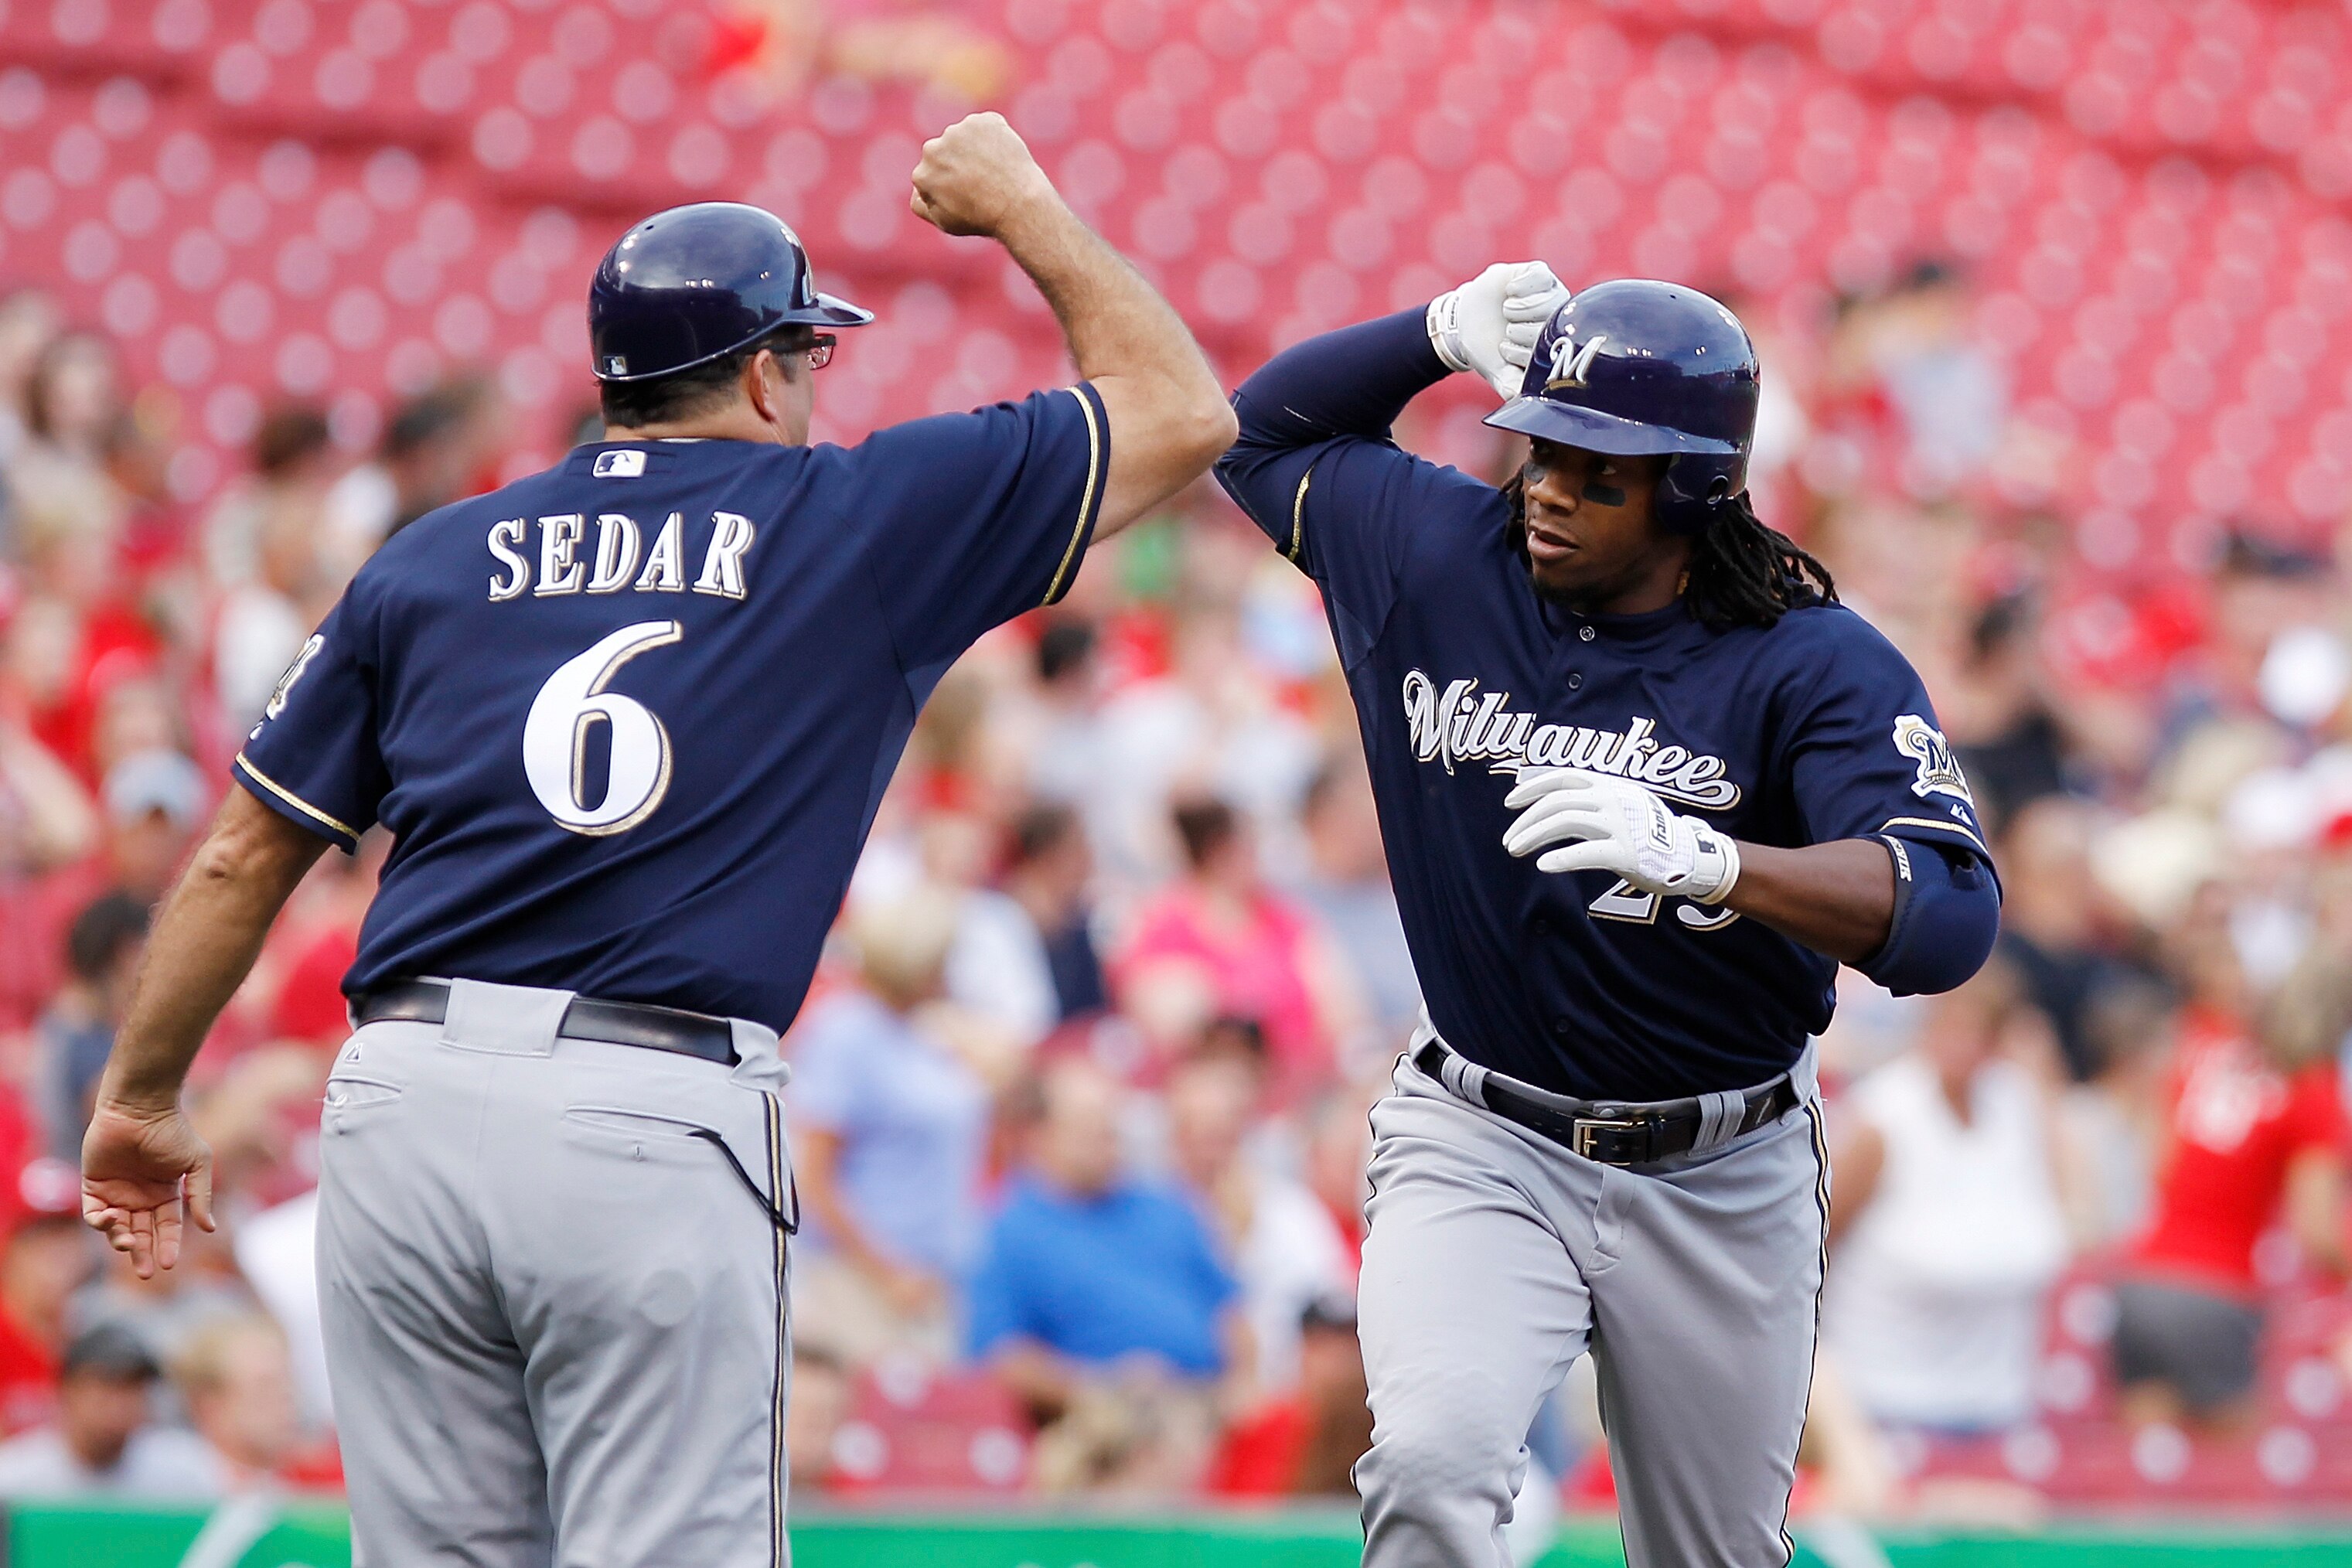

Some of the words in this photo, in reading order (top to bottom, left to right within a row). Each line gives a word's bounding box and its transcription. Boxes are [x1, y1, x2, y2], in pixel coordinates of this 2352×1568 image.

[487, 511, 755, 602] SEDAR
[521, 619, 683, 836] 6
[1403, 667, 1741, 810] Milwaukee
